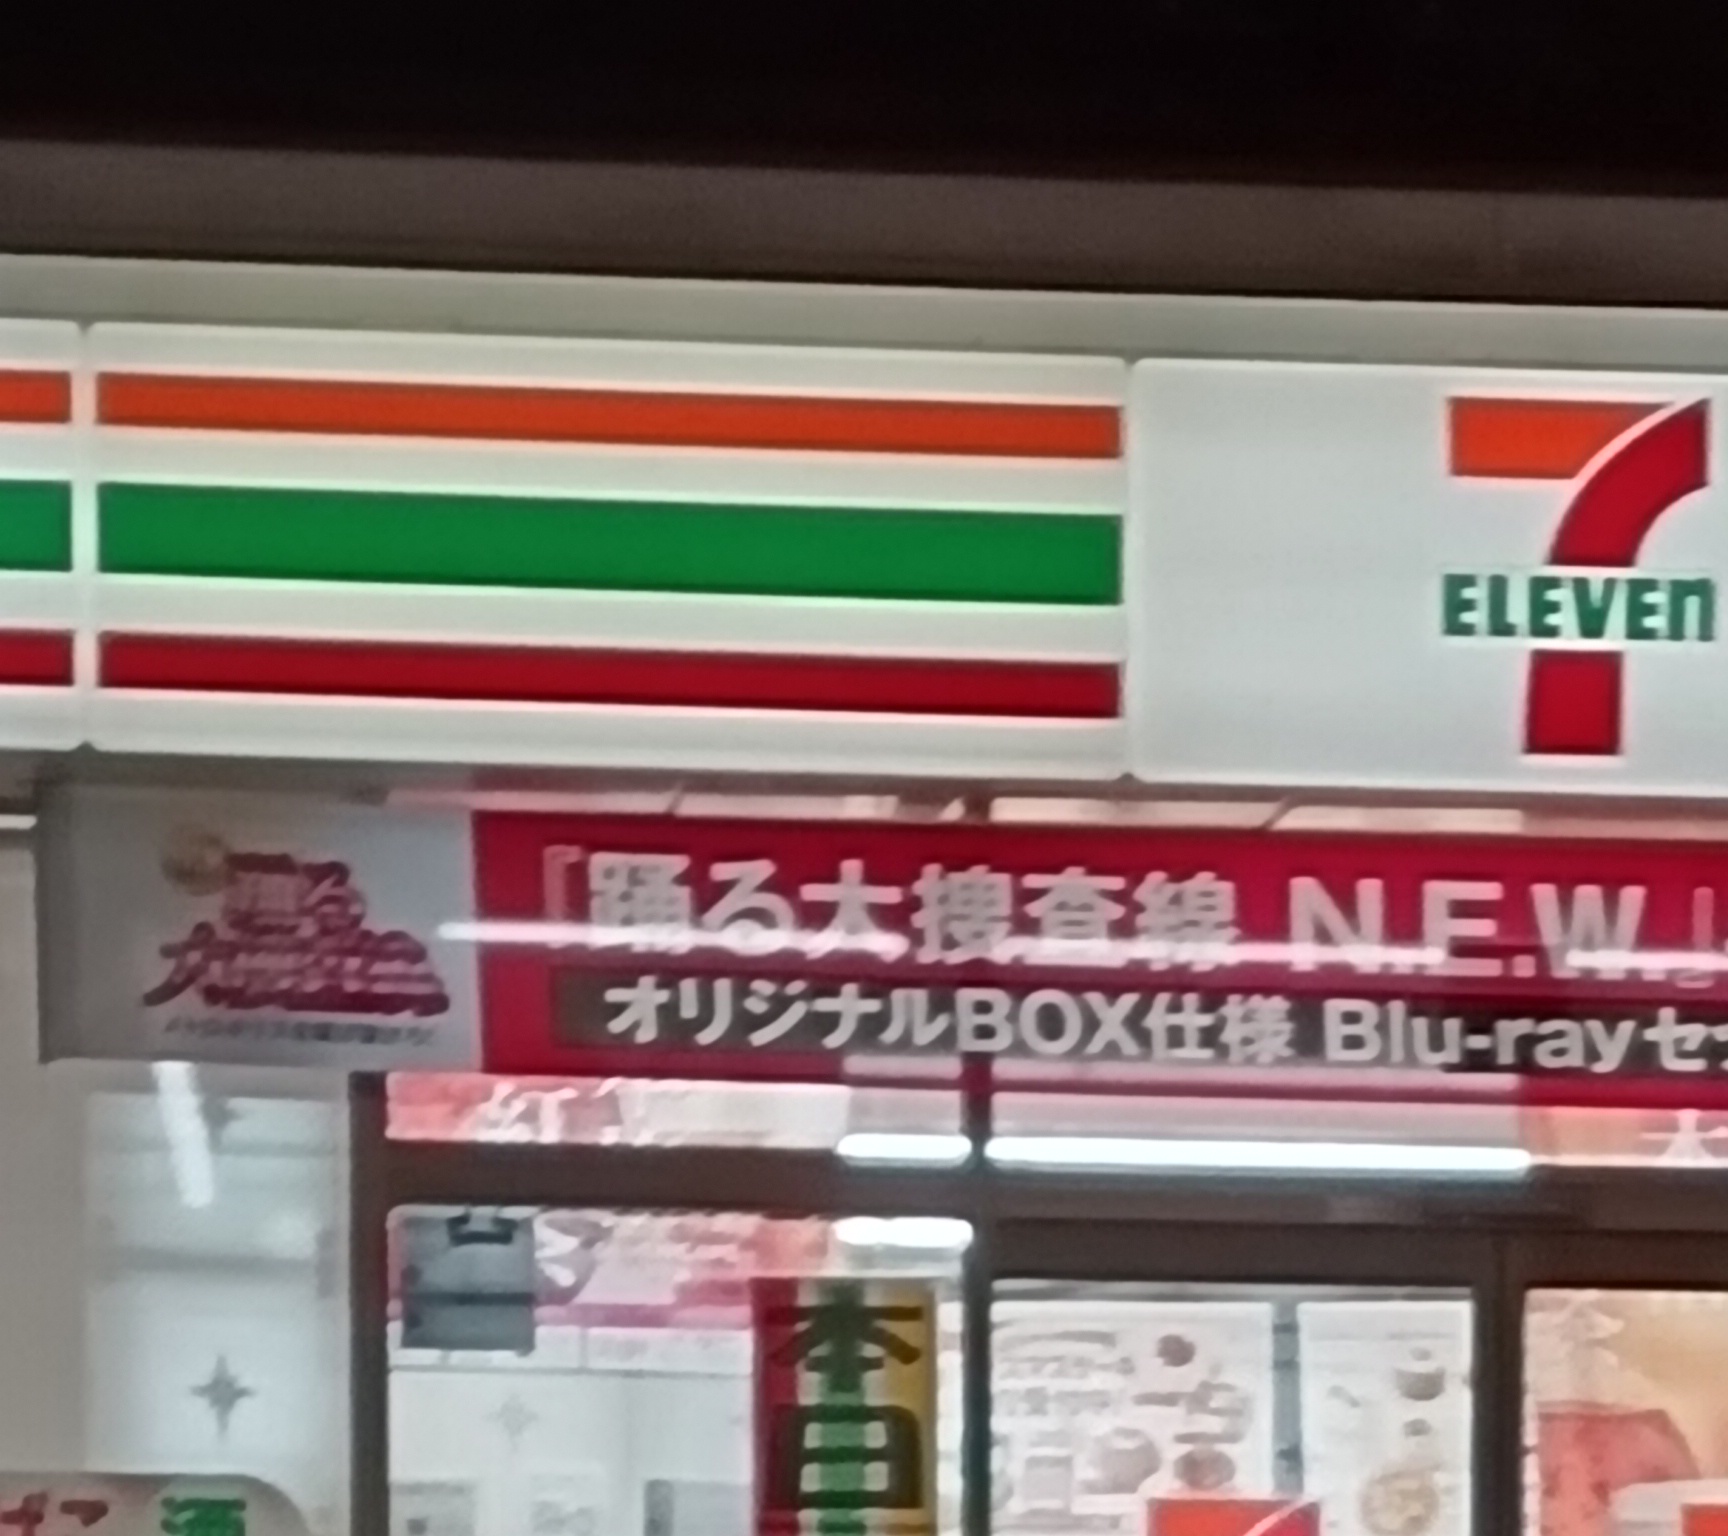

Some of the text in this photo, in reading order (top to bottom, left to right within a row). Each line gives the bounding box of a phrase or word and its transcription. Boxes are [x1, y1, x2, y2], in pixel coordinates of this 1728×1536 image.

[1446, 395, 1711, 756] 7
[603, 974, 1296, 1064] オリジナルBOX仕様
